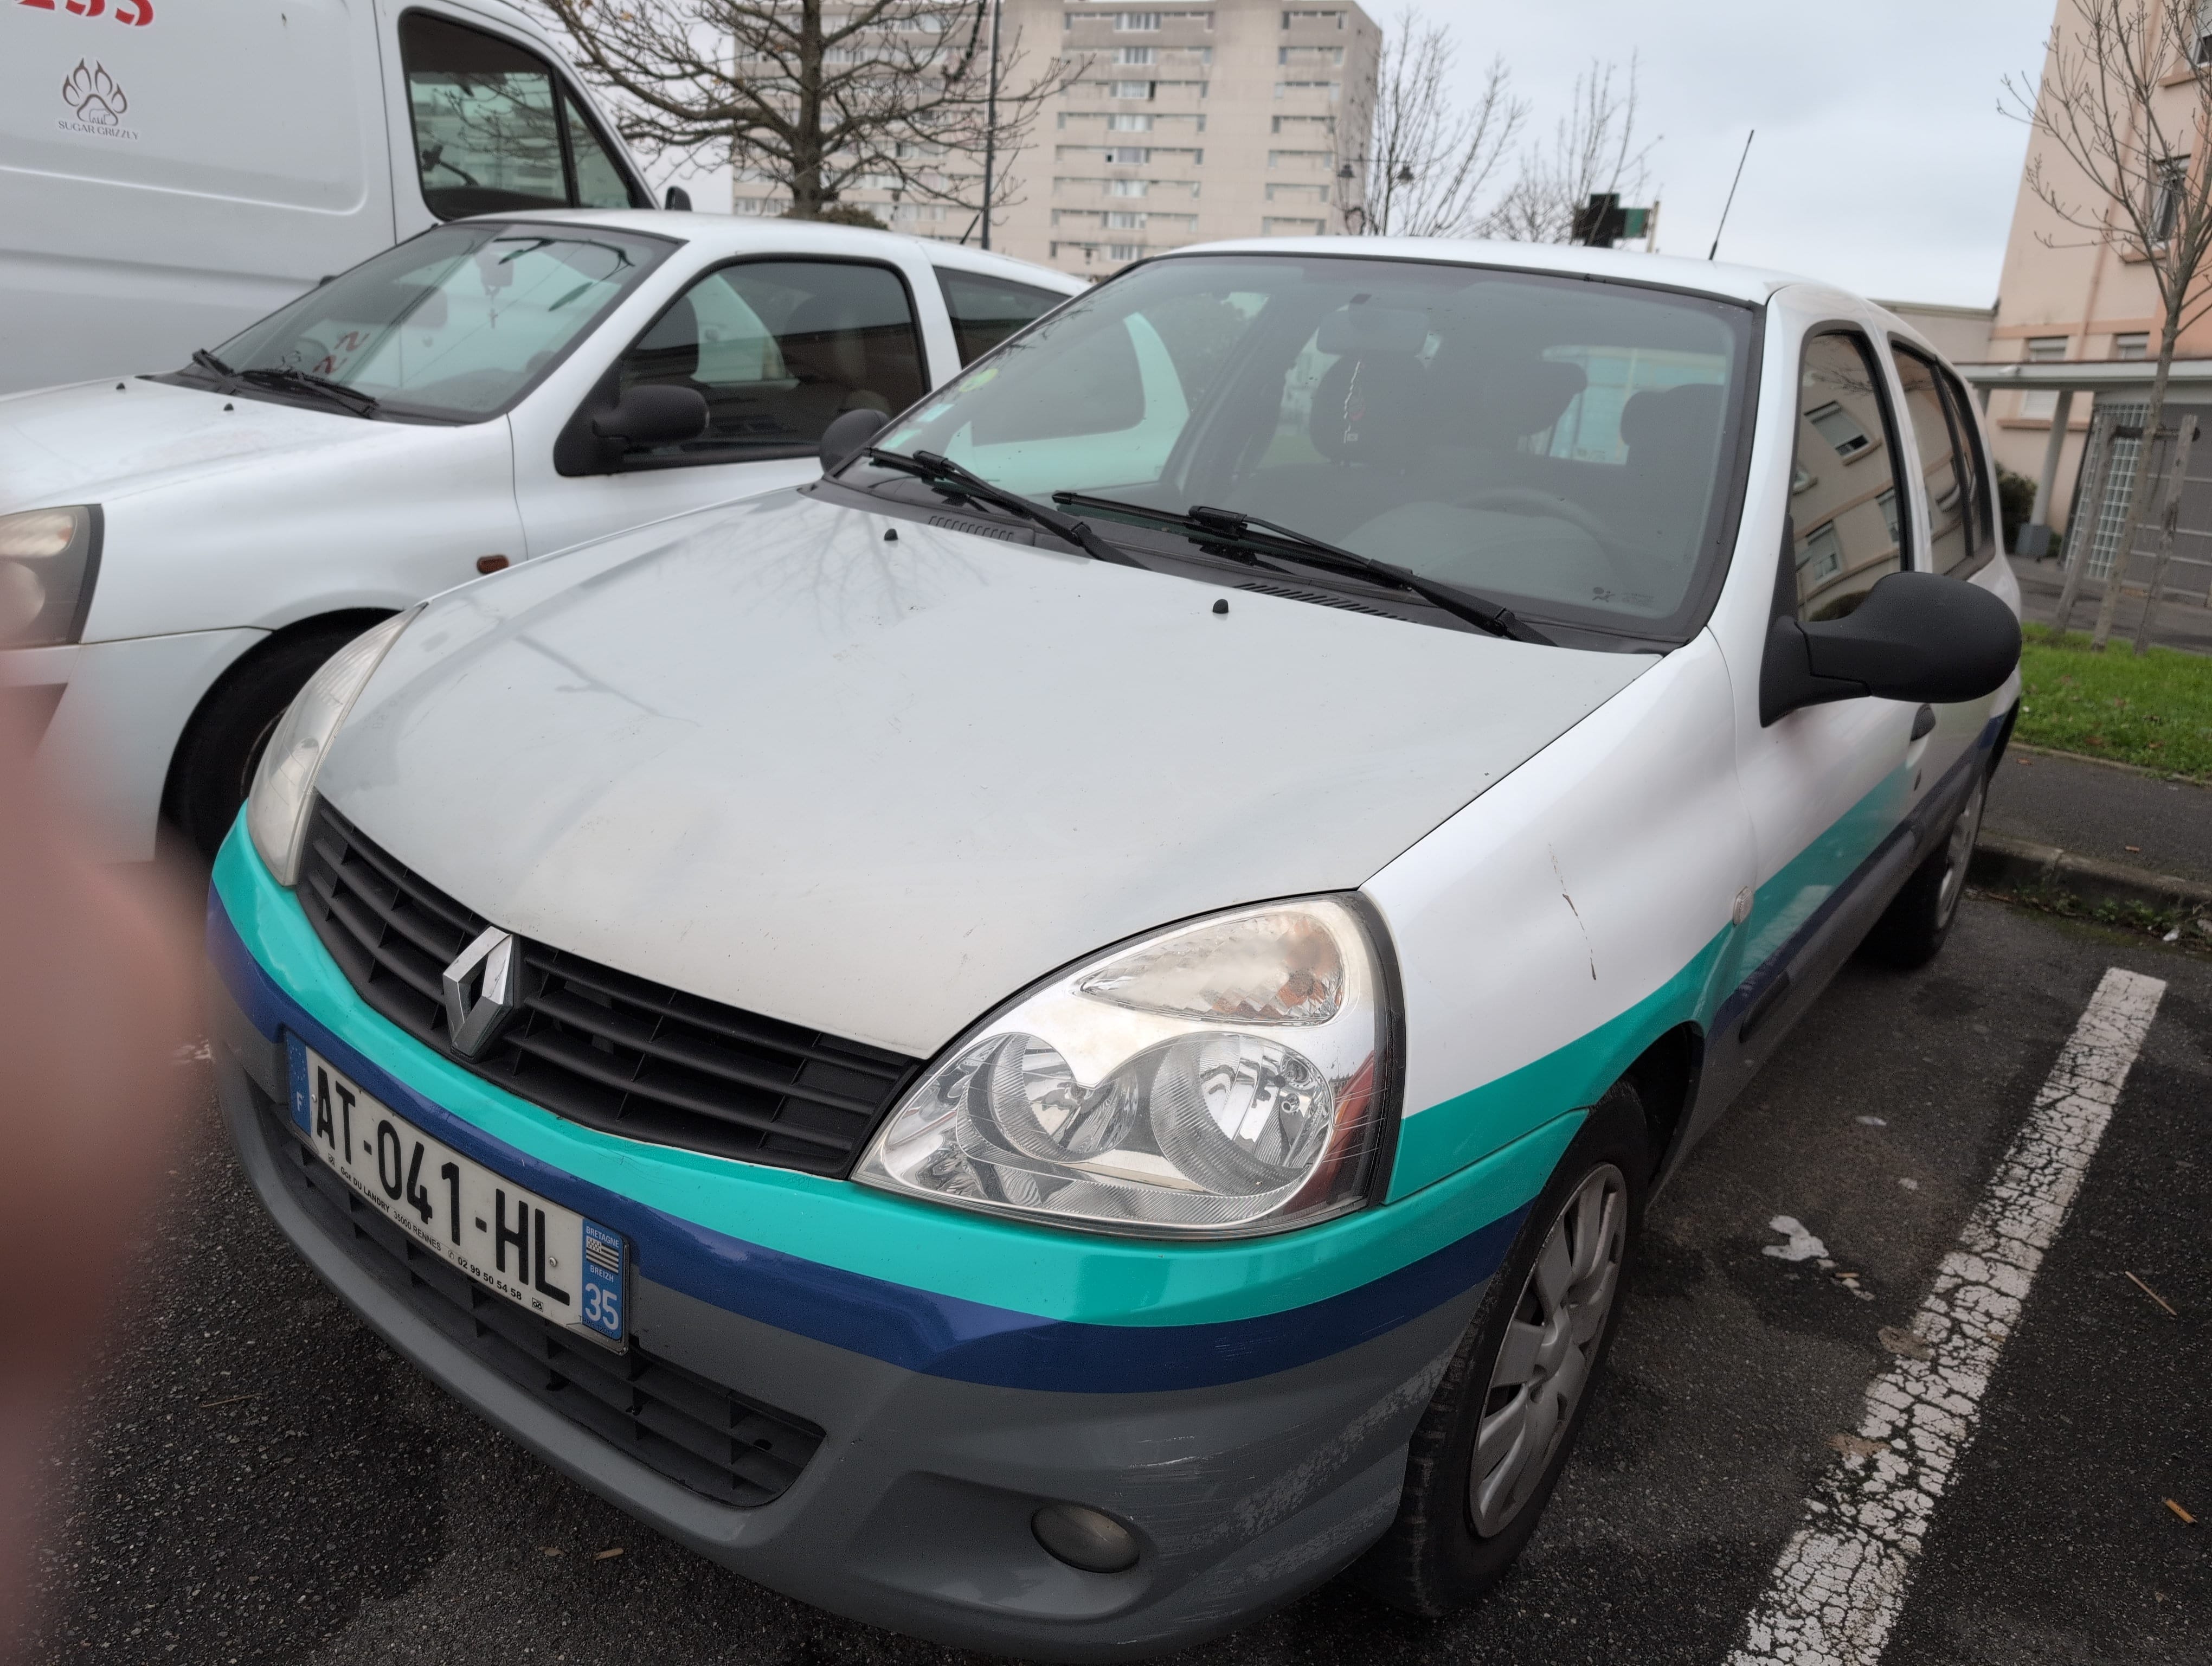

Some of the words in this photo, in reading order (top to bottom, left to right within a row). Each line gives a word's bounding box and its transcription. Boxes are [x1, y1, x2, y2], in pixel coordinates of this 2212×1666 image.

[58, 120, 95, 133] SUGAR
[97, 125, 139, 140] GRIZZLY
[297, 1091, 305, 1112] F
[316, 1065, 570, 1306] AT-041-HL
[353, 1178, 362, 1189] DU
[364, 1186, 390, 1213] LANDRY
[394, 1210, 411, 1230] 35000
[413, 1225, 441, 1251] RENNES
[586, 1226, 619, 1247] BRETAGNE
[458, 1257, 468, 1269] 02
[470, 1265, 480, 1276] 99
[483, 1273, 494, 1285] 50
[497, 1280, 508, 1293] 54
[511, 1287, 522, 1300] 58
[590, 1265, 614, 1283] BREIZH
[585, 1283, 619, 1330] 35
